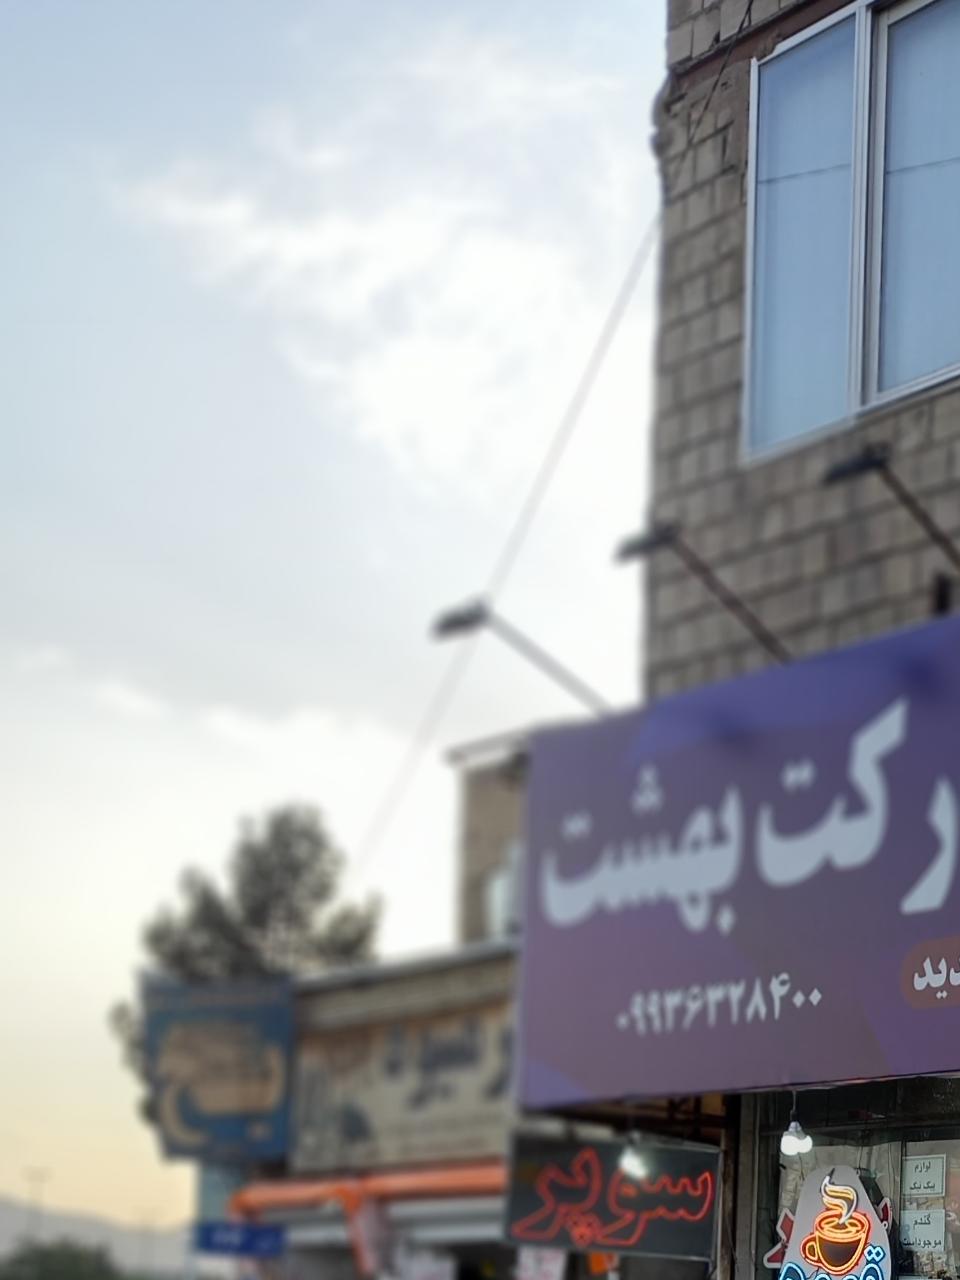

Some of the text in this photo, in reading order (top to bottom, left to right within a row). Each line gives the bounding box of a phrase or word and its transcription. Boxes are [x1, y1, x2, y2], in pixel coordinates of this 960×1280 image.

[541, 756, 745, 935] بهشت
[511, 1146, 714, 1247] سوپر
[914, 1160, 931, 1173] لوازم
